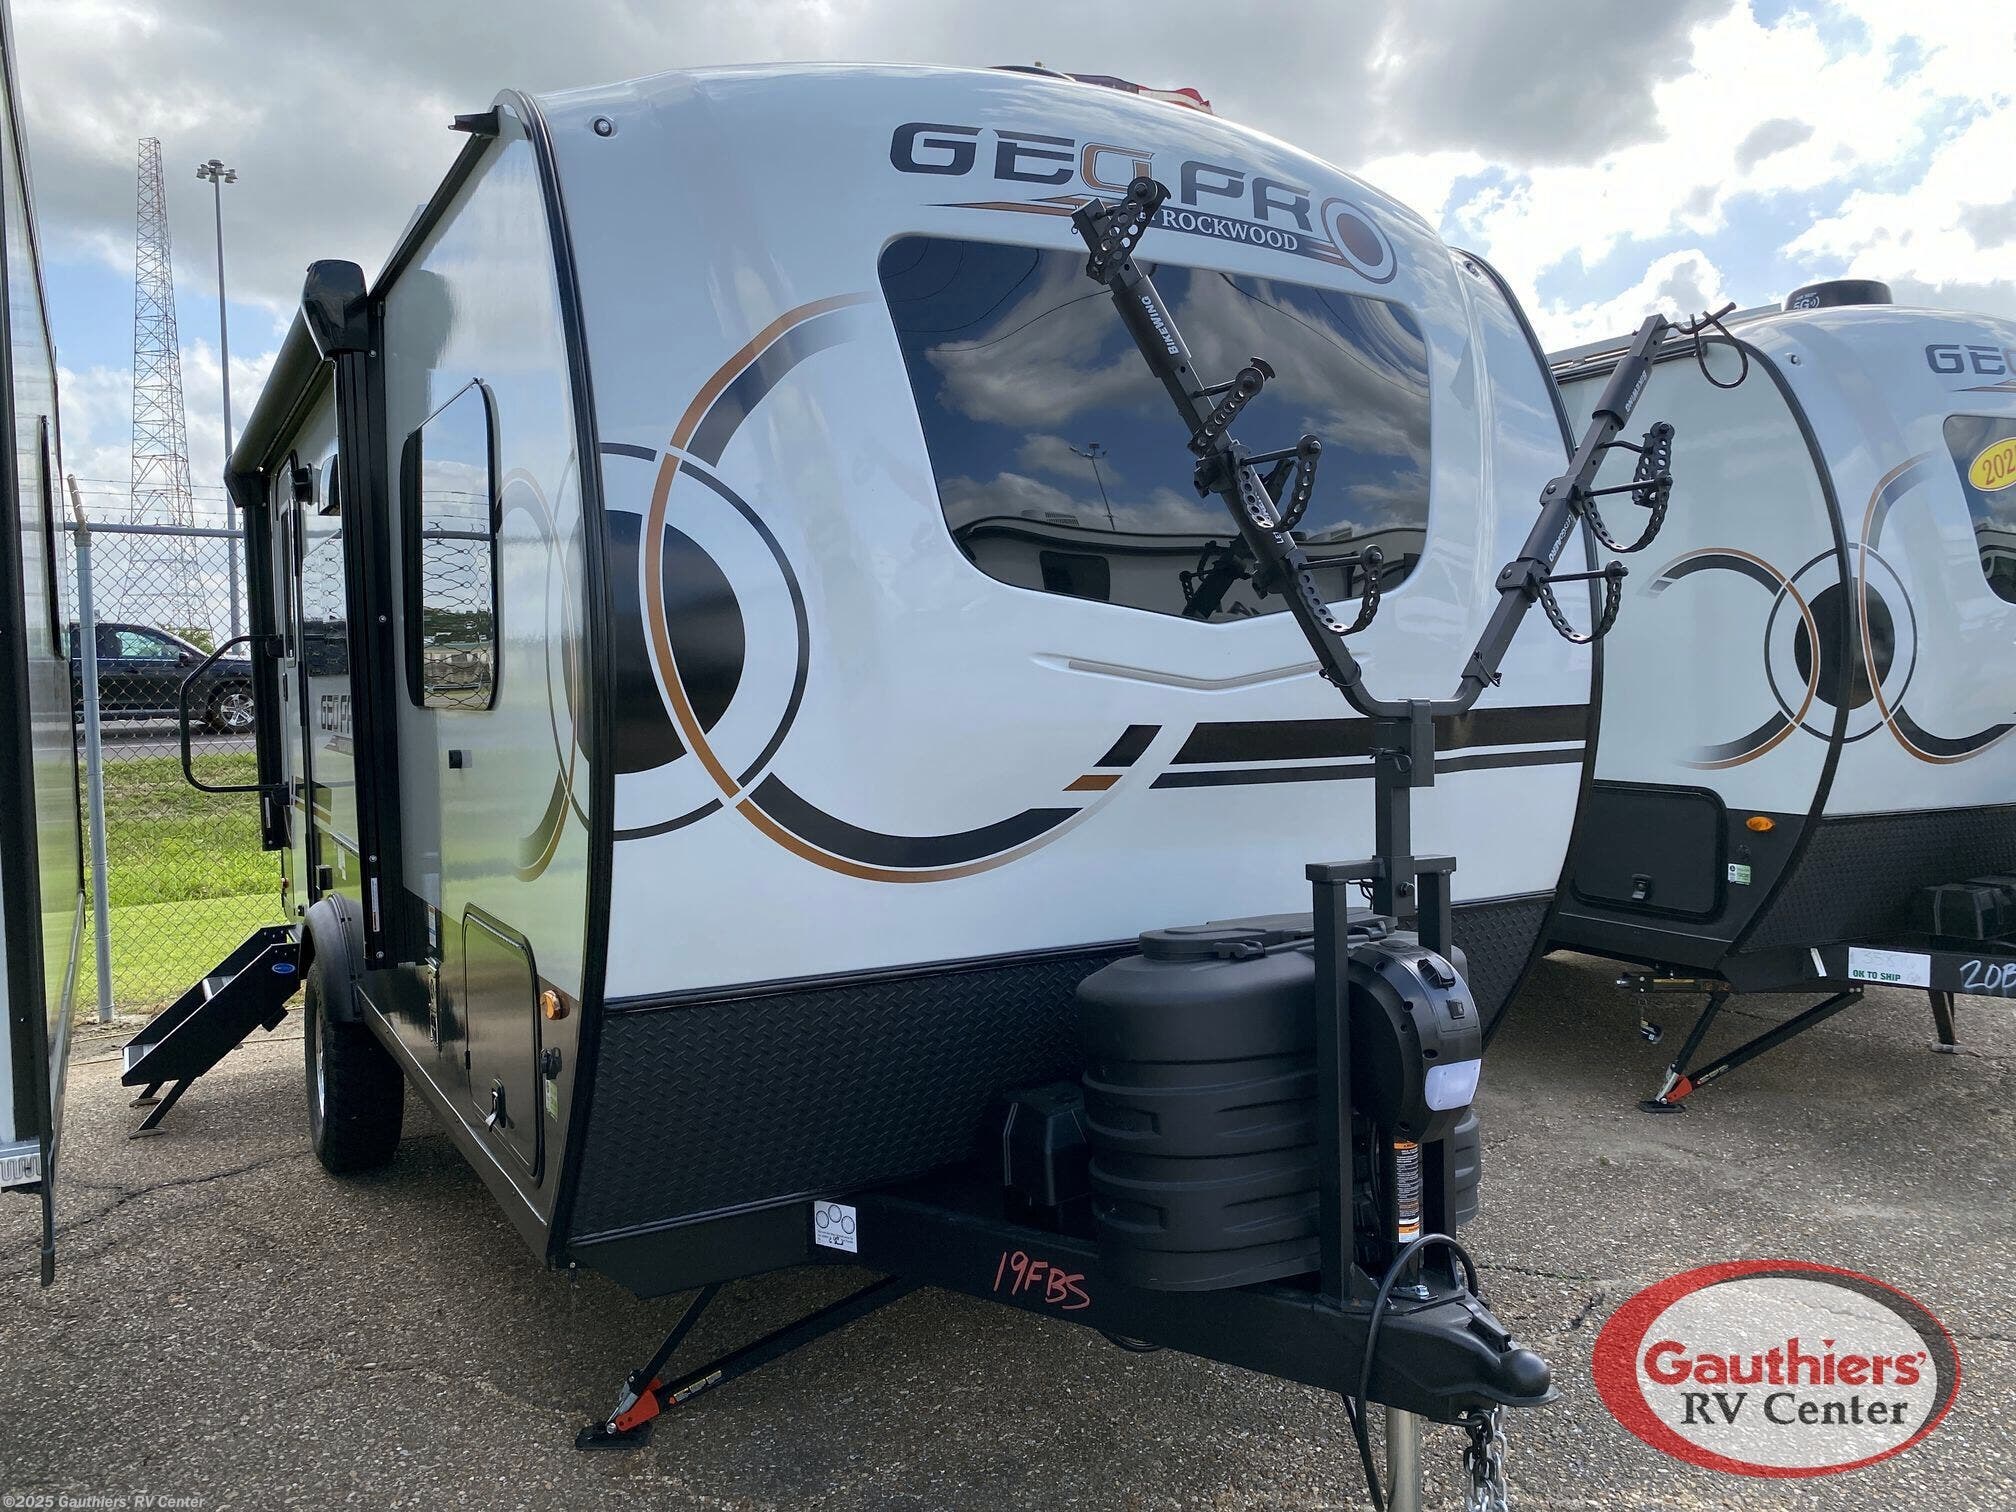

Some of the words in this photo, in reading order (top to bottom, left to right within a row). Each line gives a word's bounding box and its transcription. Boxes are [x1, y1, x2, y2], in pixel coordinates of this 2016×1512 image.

[889, 122, 1155, 193] GEO
[1161, 209, 1299, 252] ROCKWOOD
[1141, 295, 1180, 355] BIKEWING
[1982, 445, 2016, 485] 202
[1852, 969, 1866, 978] OK
[1867, 971, 1878, 980] TO
[1880, 972, 1901, 982] SHIP
[993, 1250, 1091, 1310] 19FBS
